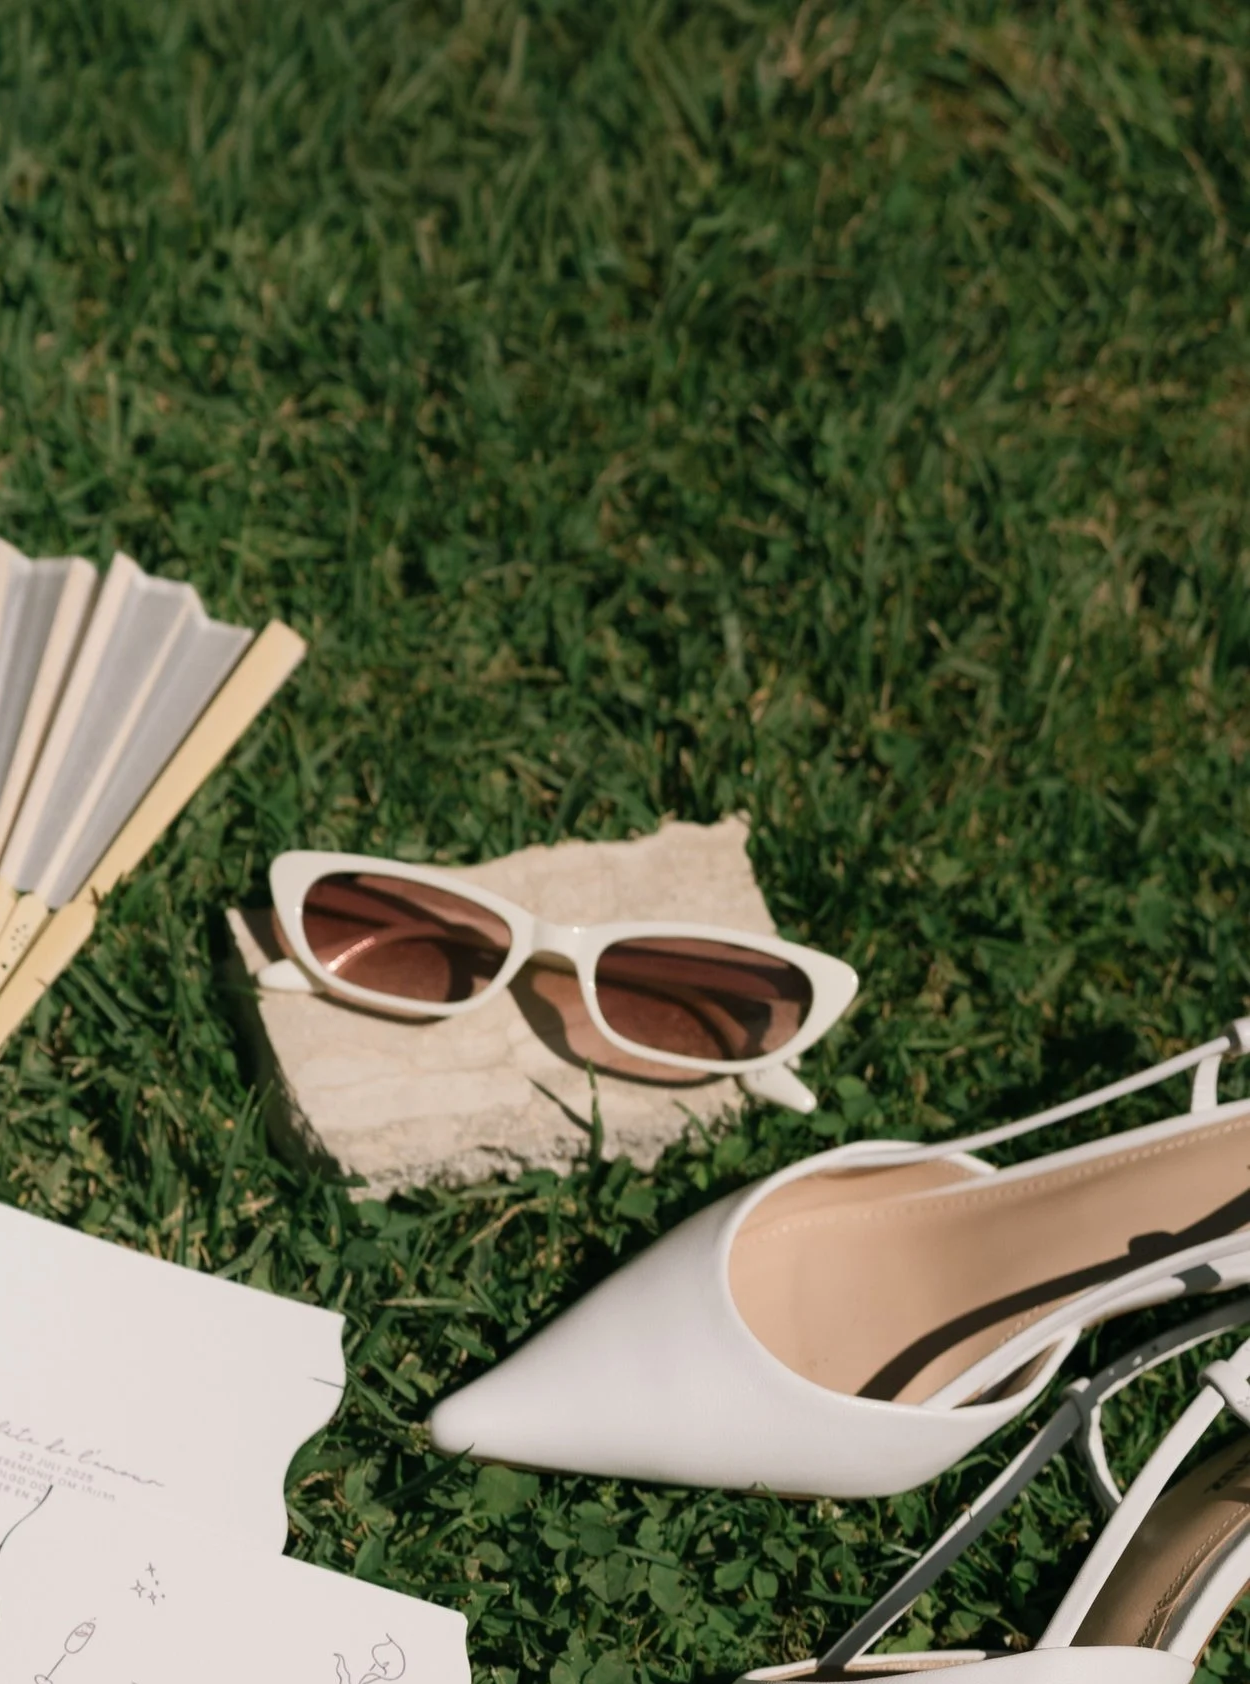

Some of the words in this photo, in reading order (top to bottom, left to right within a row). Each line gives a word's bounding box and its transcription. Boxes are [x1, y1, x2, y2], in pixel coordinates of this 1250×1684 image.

[19, 1450, 34, 1462] 22
[37, 1458, 61, 1471] JULI
[64, 1466, 94, 1484] 2025
[58, 1478, 77, 1490] OM
[14, 1488, 30, 1500] EN
